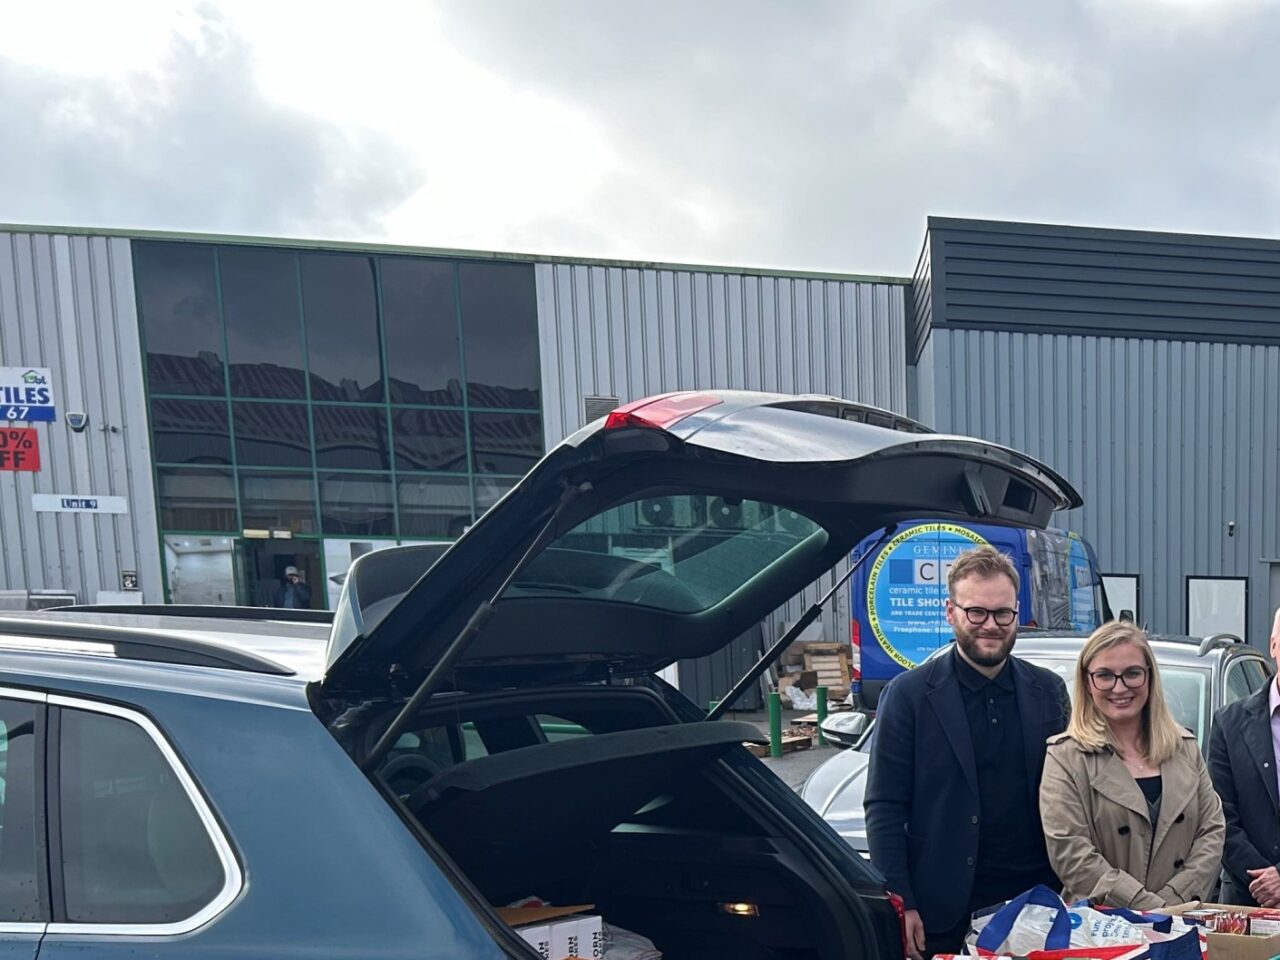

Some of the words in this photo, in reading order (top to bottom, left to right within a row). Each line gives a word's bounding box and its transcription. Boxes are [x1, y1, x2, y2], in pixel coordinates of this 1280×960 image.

[0, 386, 50, 405] ILES
[63, 500, 87, 509] Unit
[89, 500, 98, 509] 9
[889, 586, 923, 594] ceramic
[925, 586, 938, 594] tile
[889, 598, 915, 608] TILE
